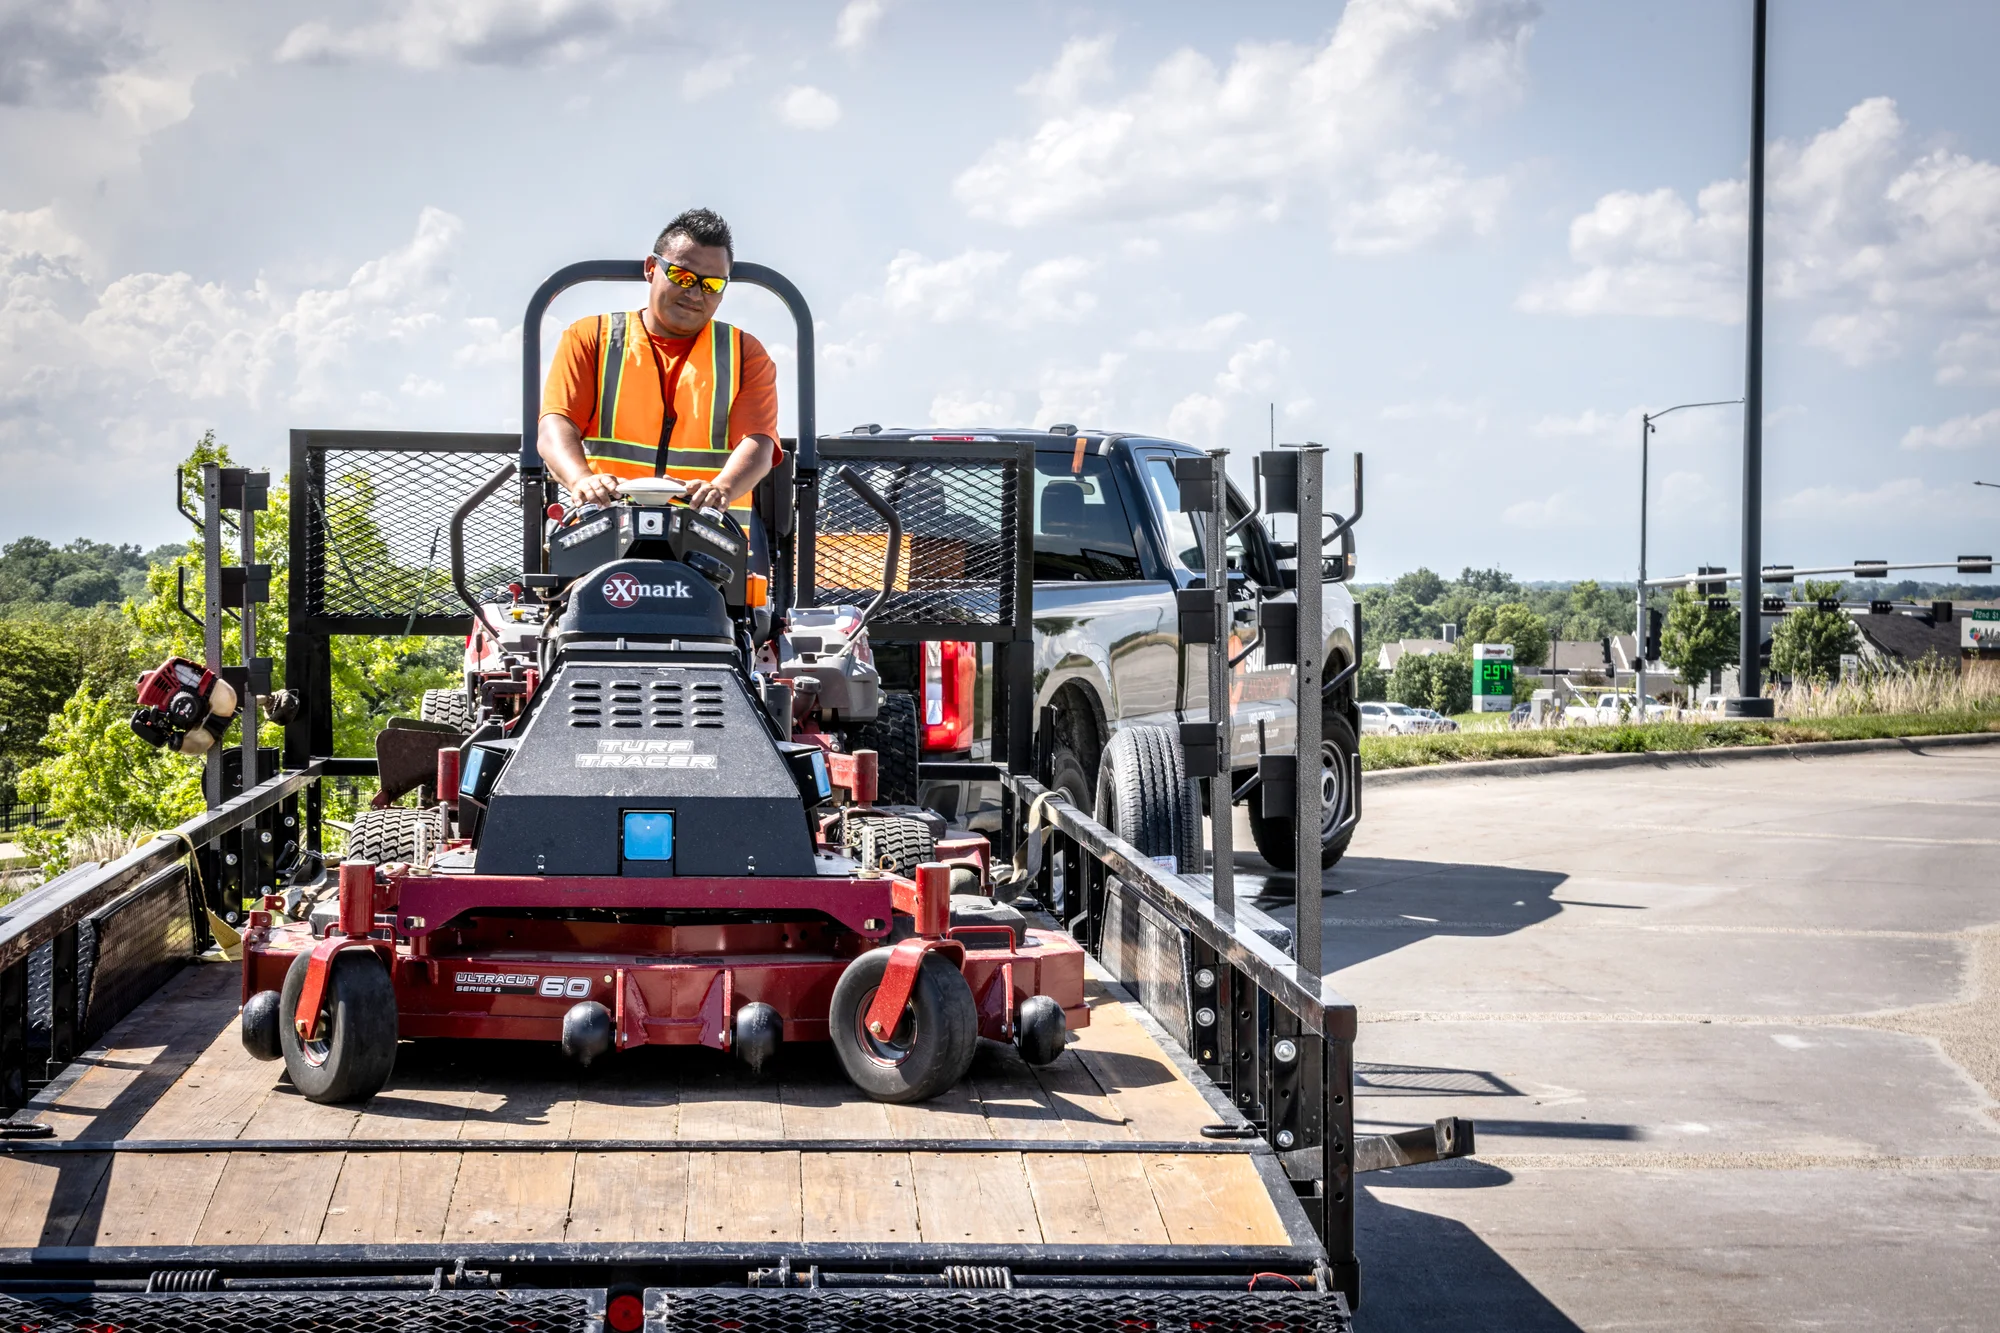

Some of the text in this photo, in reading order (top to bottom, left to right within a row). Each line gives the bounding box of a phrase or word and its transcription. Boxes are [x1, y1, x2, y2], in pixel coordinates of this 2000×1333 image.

[602, 579, 691, 602] eXmark
[1975, 610, 1990, 620] 72nd
[600, 740, 693, 754] TURF
[577, 753, 717, 768] TRACER
[455, 972, 593, 998] ULTRACUT 60
[456, 985, 492, 993] SERIES
